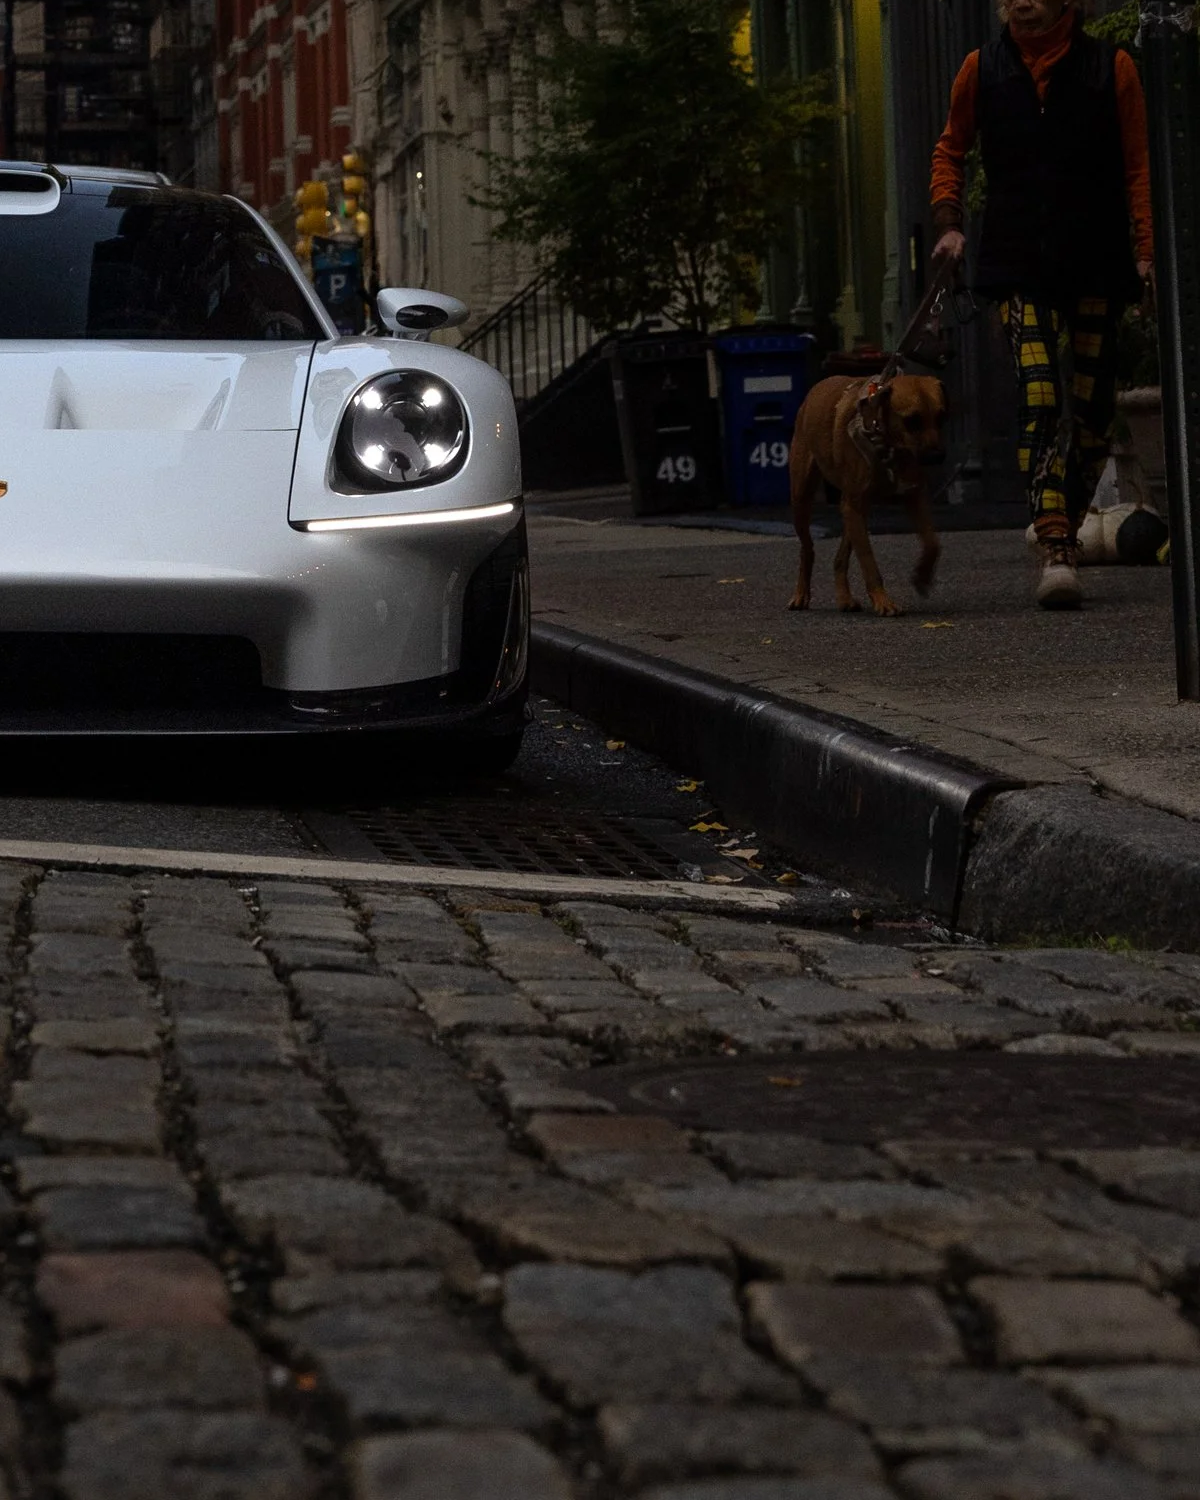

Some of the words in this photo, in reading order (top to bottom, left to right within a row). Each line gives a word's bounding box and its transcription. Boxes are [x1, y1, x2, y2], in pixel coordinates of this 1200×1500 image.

[329, 274, 347, 300] P
[750, 440, 789, 468] 49
[656, 455, 696, 483] 49
